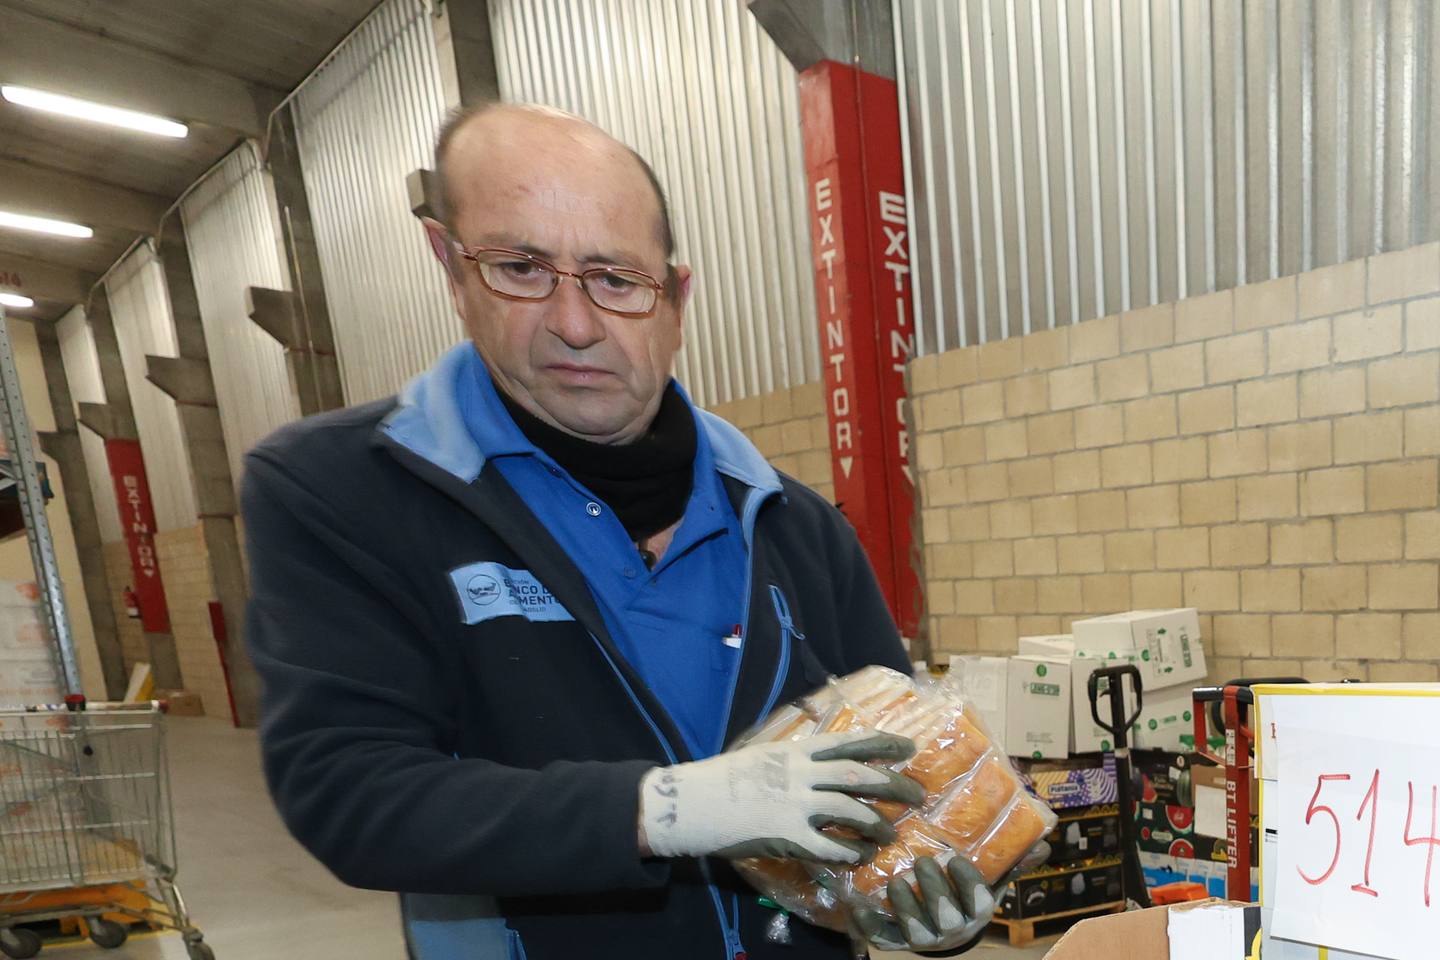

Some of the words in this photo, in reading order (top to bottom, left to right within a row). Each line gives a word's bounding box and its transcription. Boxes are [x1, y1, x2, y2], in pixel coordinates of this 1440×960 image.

[815, 178, 852, 450] EXTINTOR
[1225, 780, 1238, 801] BT
[1226, 808, 1238, 869] LIFTER
